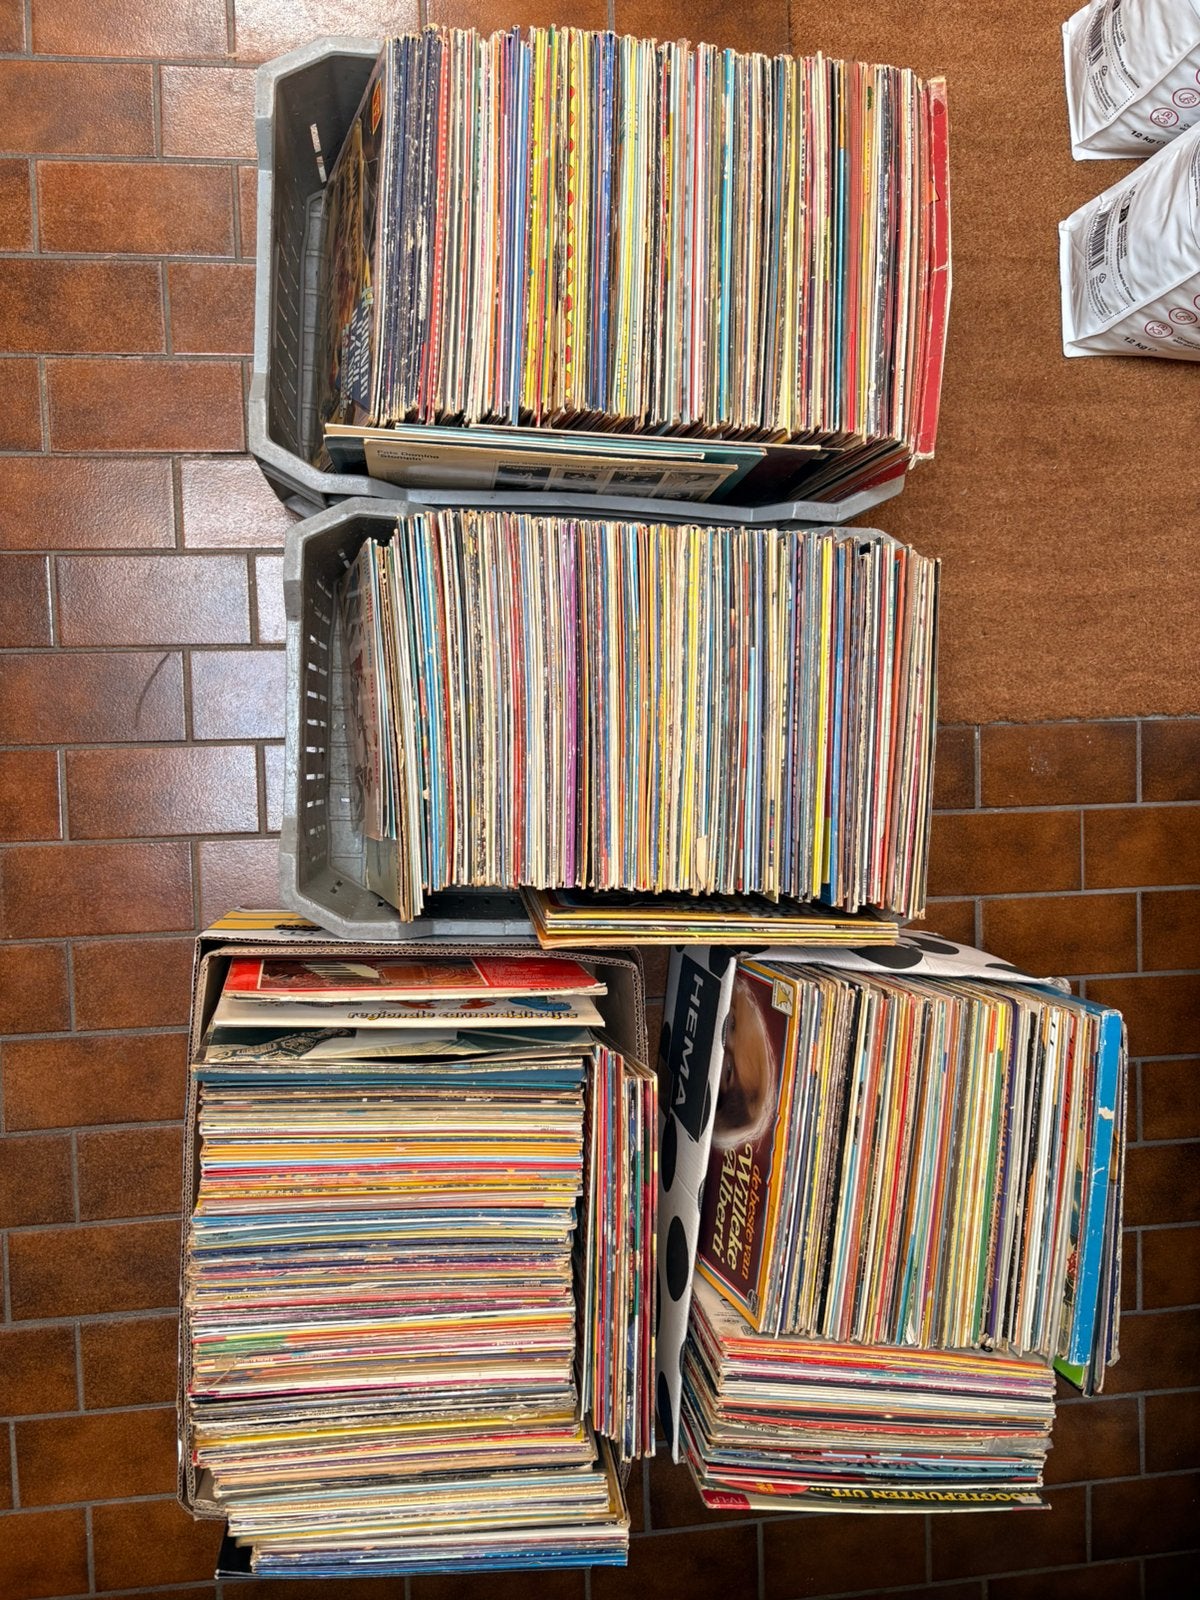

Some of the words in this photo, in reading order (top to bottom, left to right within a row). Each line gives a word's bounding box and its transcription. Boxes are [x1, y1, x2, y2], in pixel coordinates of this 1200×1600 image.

[1131, 130, 1143, 139] 12
[1143, 135, 1156, 144] kg
[1135, 342, 1148, 350] kg
[348, 1010, 435, 1020] regionale
[675, 973, 704, 1105] HEMA
[712, 1148, 737, 1264] Alberti
[727, 1143, 753, 1271] Willeke
[741, 1243, 752, 1280] van
